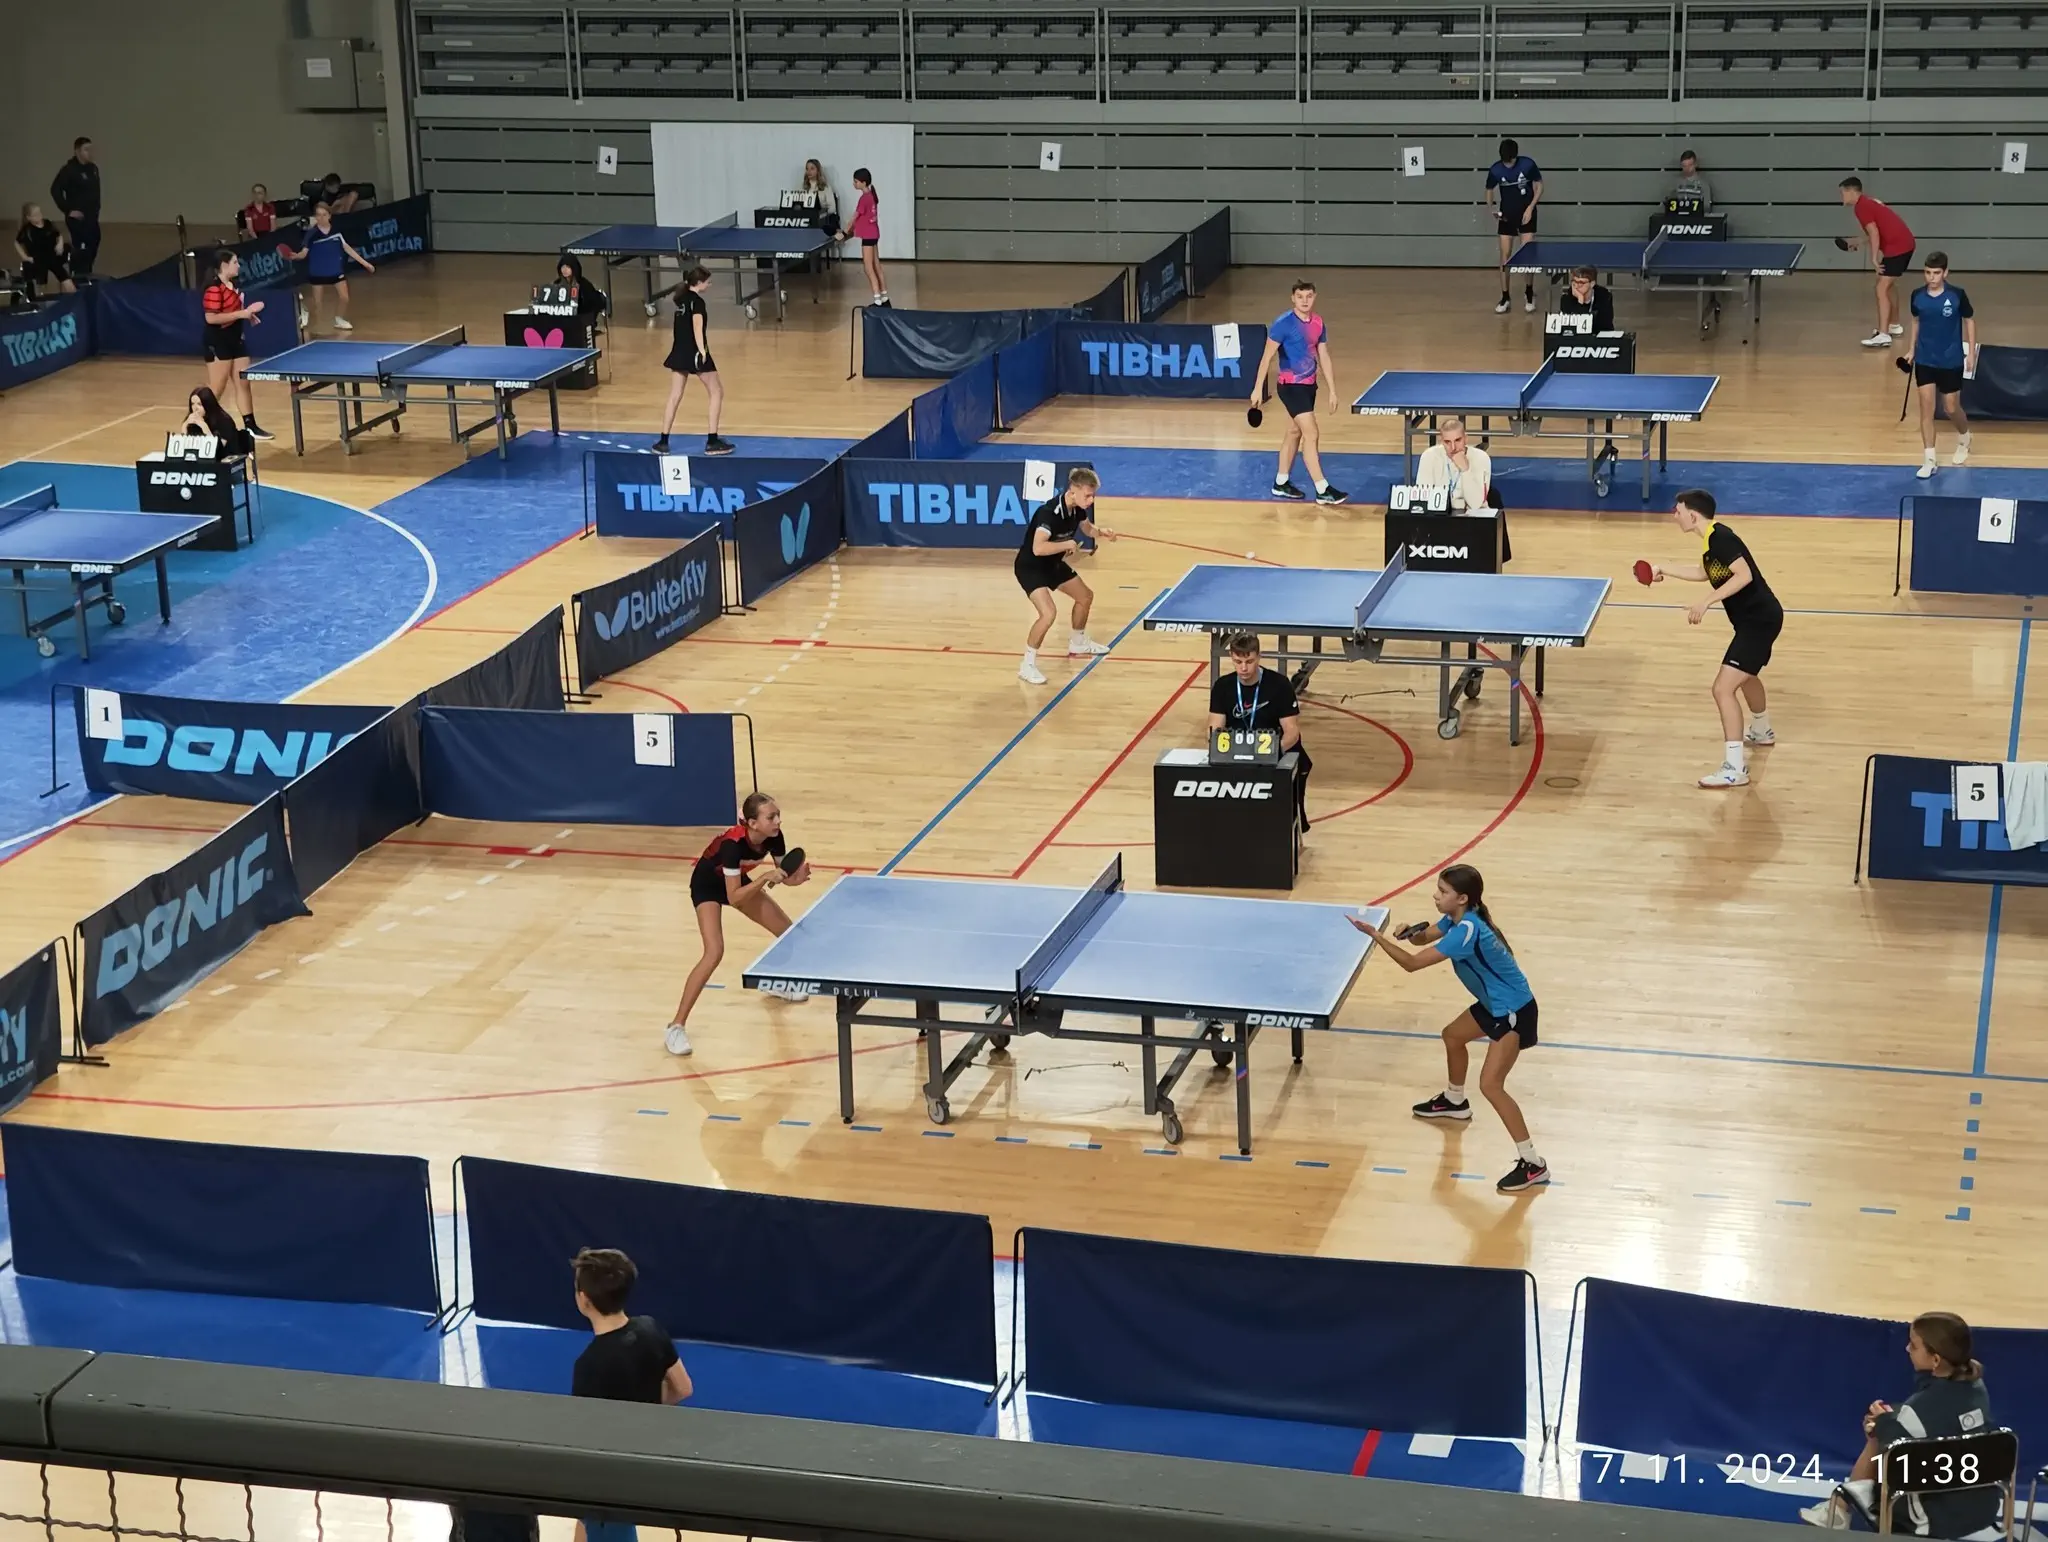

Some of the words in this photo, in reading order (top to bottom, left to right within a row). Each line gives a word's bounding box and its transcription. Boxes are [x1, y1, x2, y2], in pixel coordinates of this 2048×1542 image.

[604, 155, 612, 165] 4
[1046, 151, 1054, 162] 4
[1410, 155, 1419, 167] 8
[2010, 151, 2020, 163] 8
[1670, 201, 1677, 211] 3
[1692, 201, 1699, 211] 7
[763, 217, 810, 227] DONIC
[1660, 224, 1713, 235] DONIC
[543, 288, 551, 302] 7
[558, 287, 567, 302] 9
[2, 312, 77, 367] TIBHAR
[1223, 335, 1232, 348] 7
[1556, 346, 1620, 358] DONIC
[247, 373, 280, 381] DONIC
[495, 380, 530, 389] DONIC
[1360, 407, 1399, 415] DONIC
[1651, 413, 1692, 421] DONIC
[150, 471, 217, 486] DONIC
[672, 468, 682, 481] 2
[1035, 475, 1046, 487] 6
[1990, 512, 2002, 527] 6
[1409, 544, 1468, 559] XIOM
[71, 563, 114, 574] DONIC
[631, 559, 707, 631] Butterfly
[1155, 623, 1203, 633] DONIC
[1522, 636, 1573, 647] DONIC
[102, 706, 110, 722] 1
[646, 730, 659, 748] 5
[1217, 732, 1230, 753] 6
[1235, 733, 1243, 744] 0
[1246, 733, 1254, 744] 0
[1258, 733, 1272, 754] 2
[103, 719, 358, 777] DONI
[1173, 780, 1273, 799] DONIC
[1970, 782, 1986, 802] 5
[96, 832, 268, 999] DONIC
[758, 979, 821, 993] DONIC
[833, 987, 878, 997] DELHI
[1246, 1013, 1314, 1029] DONIC
